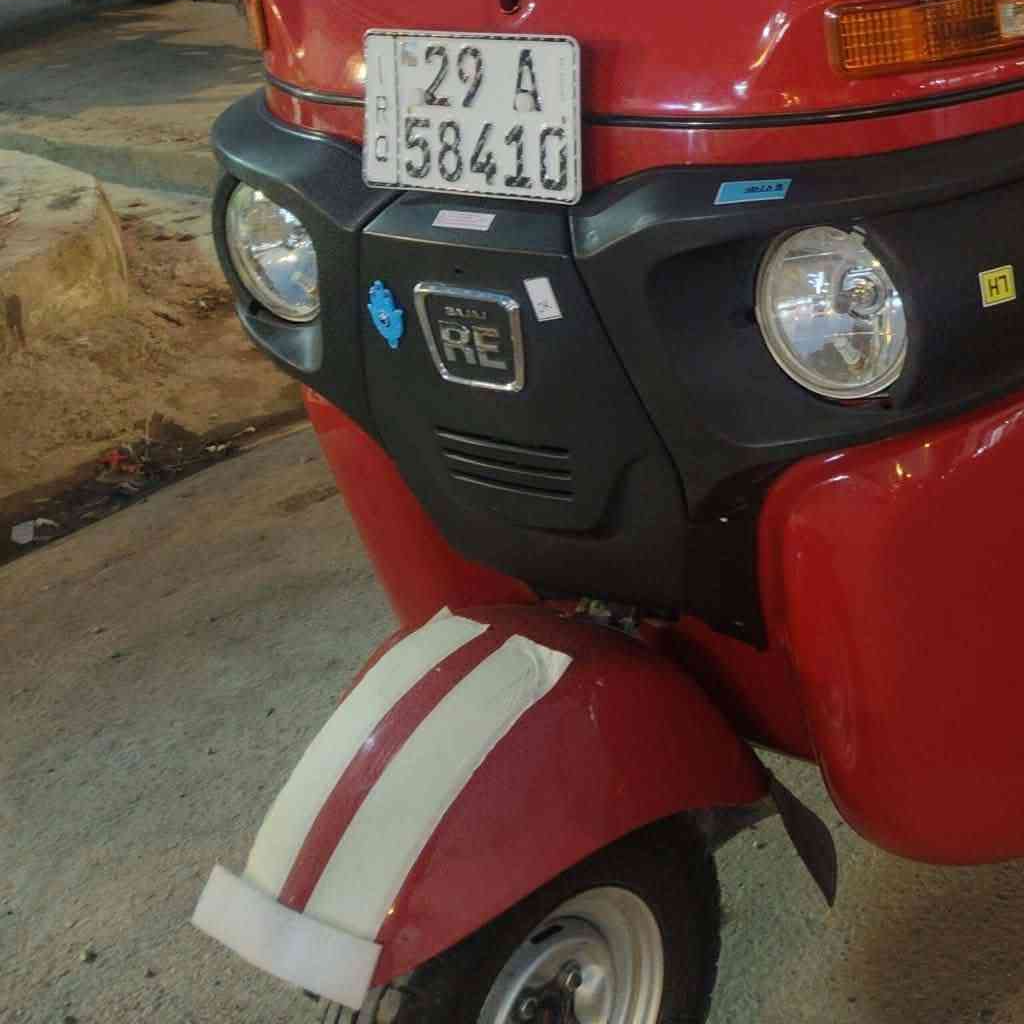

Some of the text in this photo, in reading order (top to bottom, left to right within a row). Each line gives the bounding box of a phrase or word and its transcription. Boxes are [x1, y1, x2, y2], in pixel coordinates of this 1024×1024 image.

[424, 45, 543, 113] 29 A
[404, 116, 569, 192] 58410
[437, 319, 508, 370] RE
